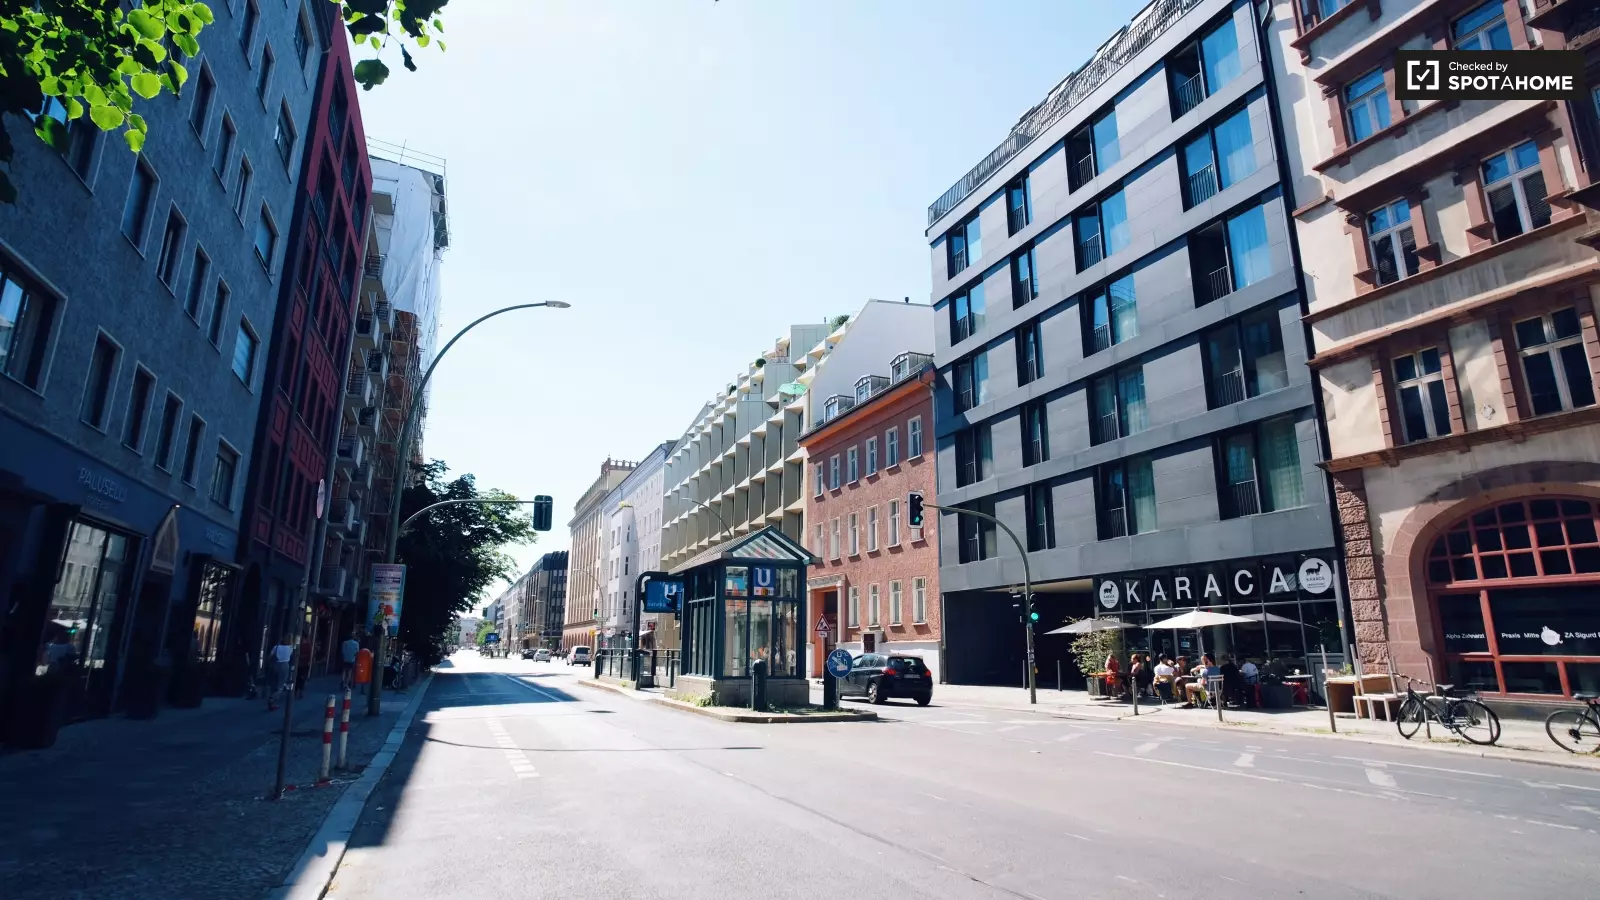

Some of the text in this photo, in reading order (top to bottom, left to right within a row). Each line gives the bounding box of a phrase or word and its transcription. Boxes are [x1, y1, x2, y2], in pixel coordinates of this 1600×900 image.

[755, 567, 771, 587] U
[1126, 566, 1290, 604] KARACA
[660, 581, 677, 600] U
[1564, 631, 1575, 639] ZA
[1574, 631, 1597, 640] Sigurd
